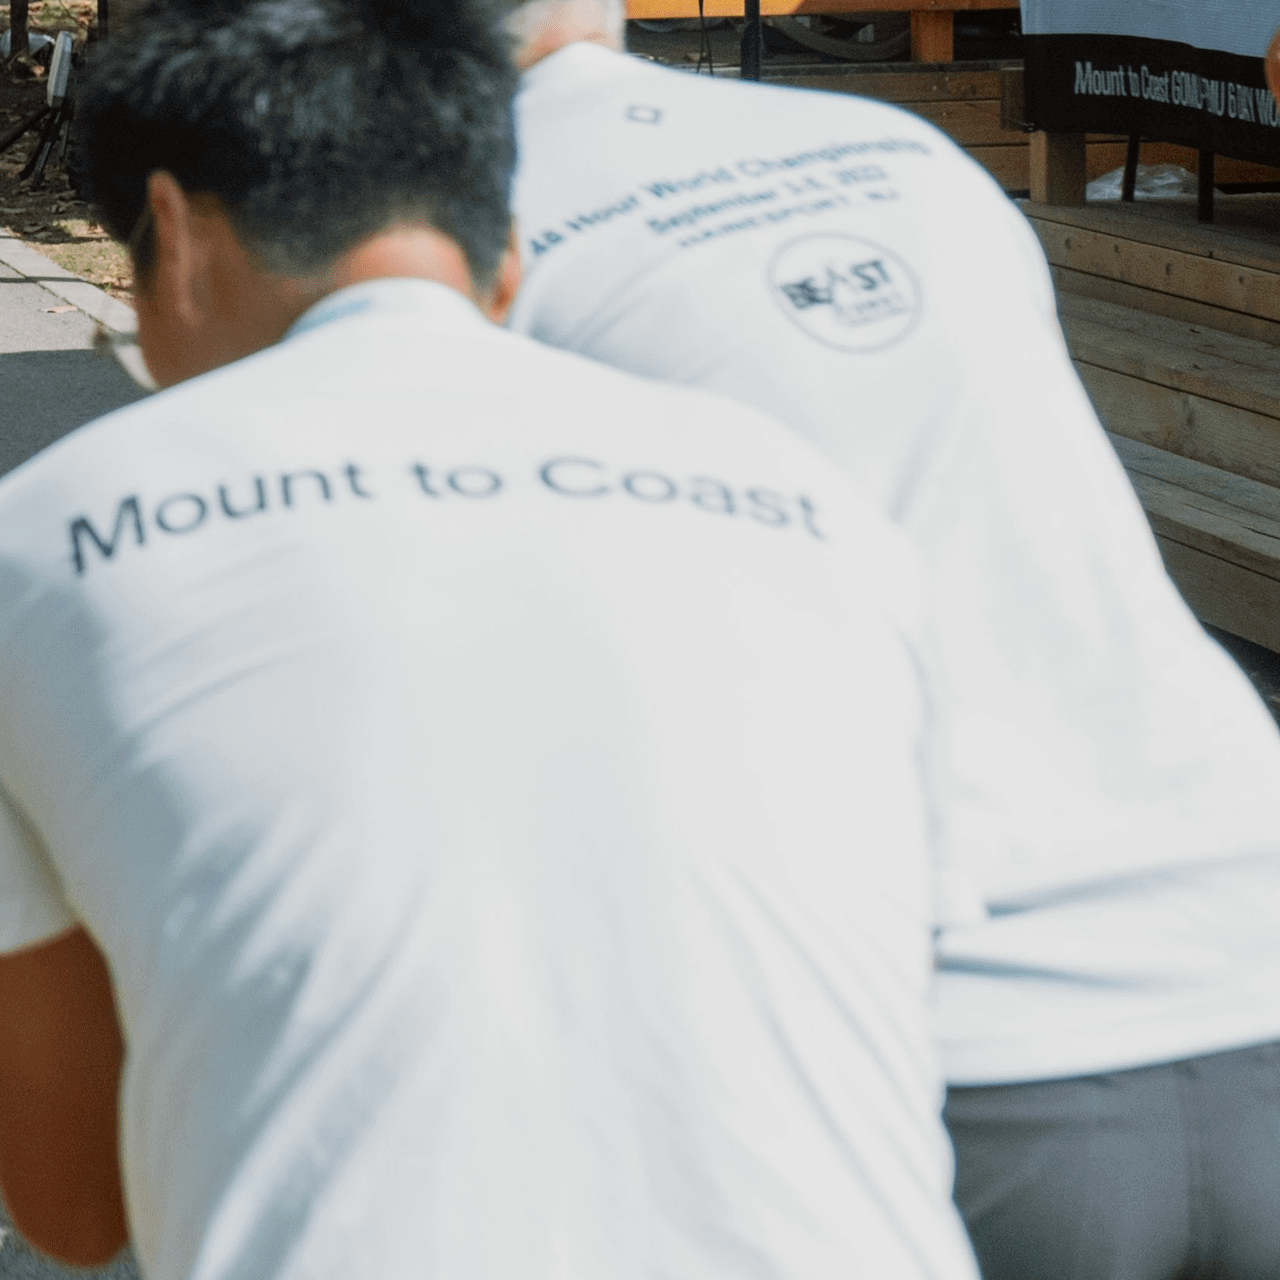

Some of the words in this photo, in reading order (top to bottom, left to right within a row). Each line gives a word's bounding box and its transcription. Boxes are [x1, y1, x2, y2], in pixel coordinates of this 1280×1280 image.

[65, 458, 370, 577] Mount
[410, 456, 504, 497] to
[537, 454, 829, 543] Coast
